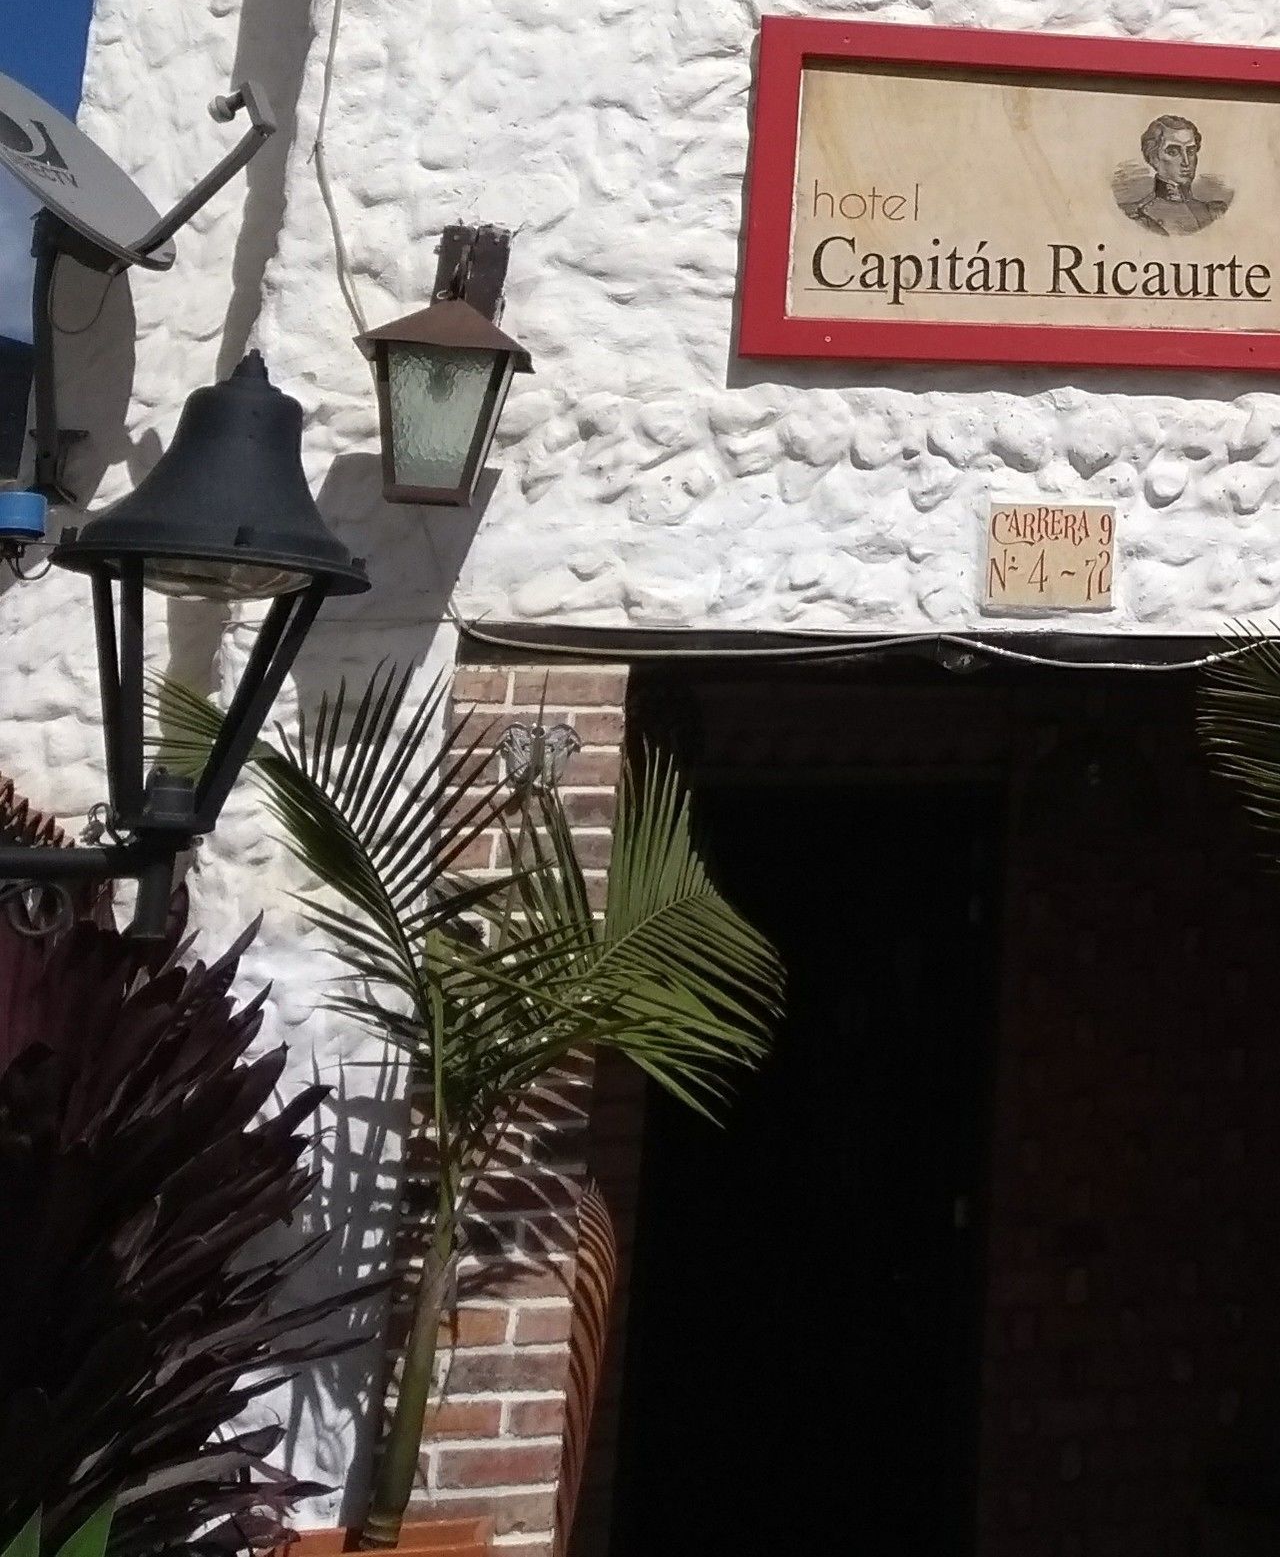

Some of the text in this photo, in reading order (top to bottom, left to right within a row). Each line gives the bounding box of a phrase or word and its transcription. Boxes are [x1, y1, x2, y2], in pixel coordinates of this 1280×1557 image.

[814, 178, 921, 222] hotel
[811, 234, 1272, 306] Capitán Ricaurte
[991, 506, 1113, 547] CARRERA 9
[1027, 548, 1049, 594] 4
[1084, 549, 1112, 602] 72
